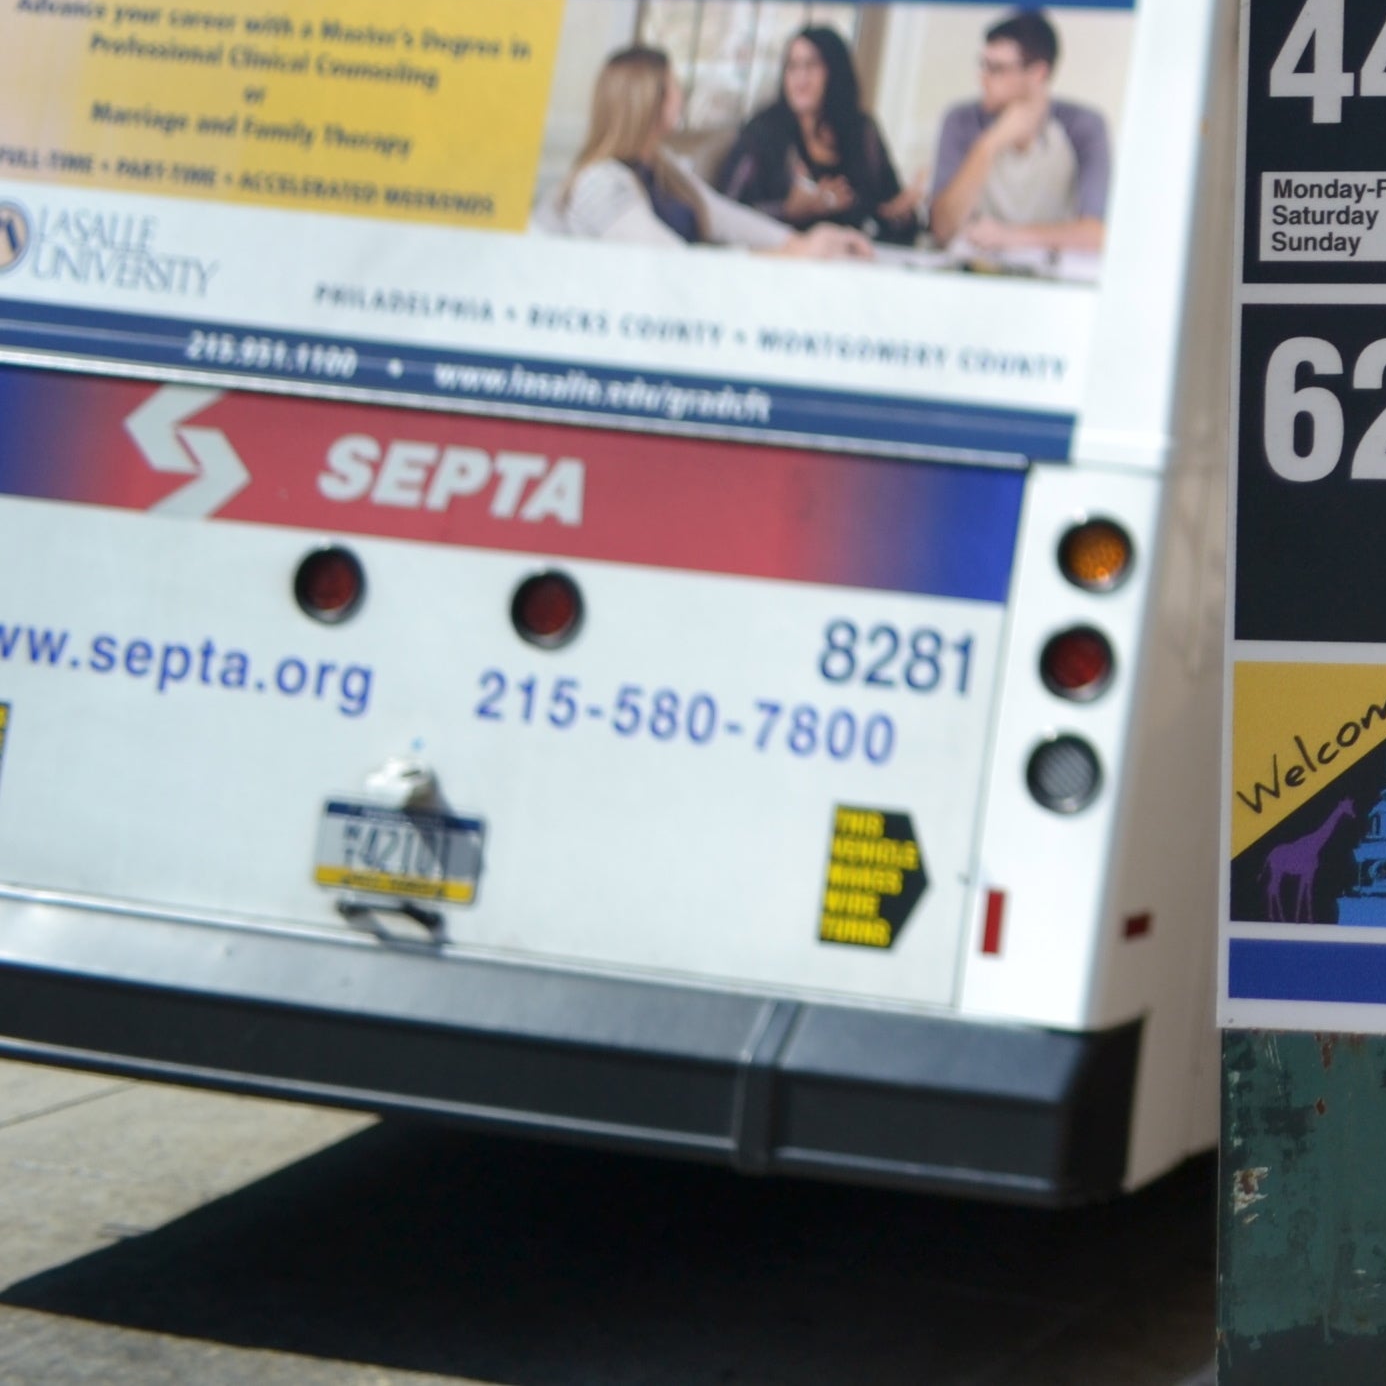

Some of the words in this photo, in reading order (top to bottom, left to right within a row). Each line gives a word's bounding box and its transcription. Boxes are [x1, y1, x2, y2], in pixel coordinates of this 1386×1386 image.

[115, 5, 162, 27] your
[169, 10, 236, 30] career
[245, 14, 294, 35] with
[421, 27, 502, 60] Degree
[510, 36, 530, 59] in
[90, 33, 223, 63] Professional
[230, 45, 309, 71] Clinical
[315, 53, 440, 92] Counseling
[92, 100, 188, 137] Marriage
[196, 113, 238, 135] and
[243, 117, 315, 149] Family
[323, 123, 412, 159] Therapy
[1271, 230, 1362, 257] Sunday
[1272, 204, 1380, 231] Saturday
[31, 241, 221, 298] UNIVERSITY
[314, 283, 494, 324] PHILADELPHIA
[316, 433, 586, 526] SEPTA
[818, 620, 977, 698] 8281
[475, 670, 896, 766] 215-580-7800
